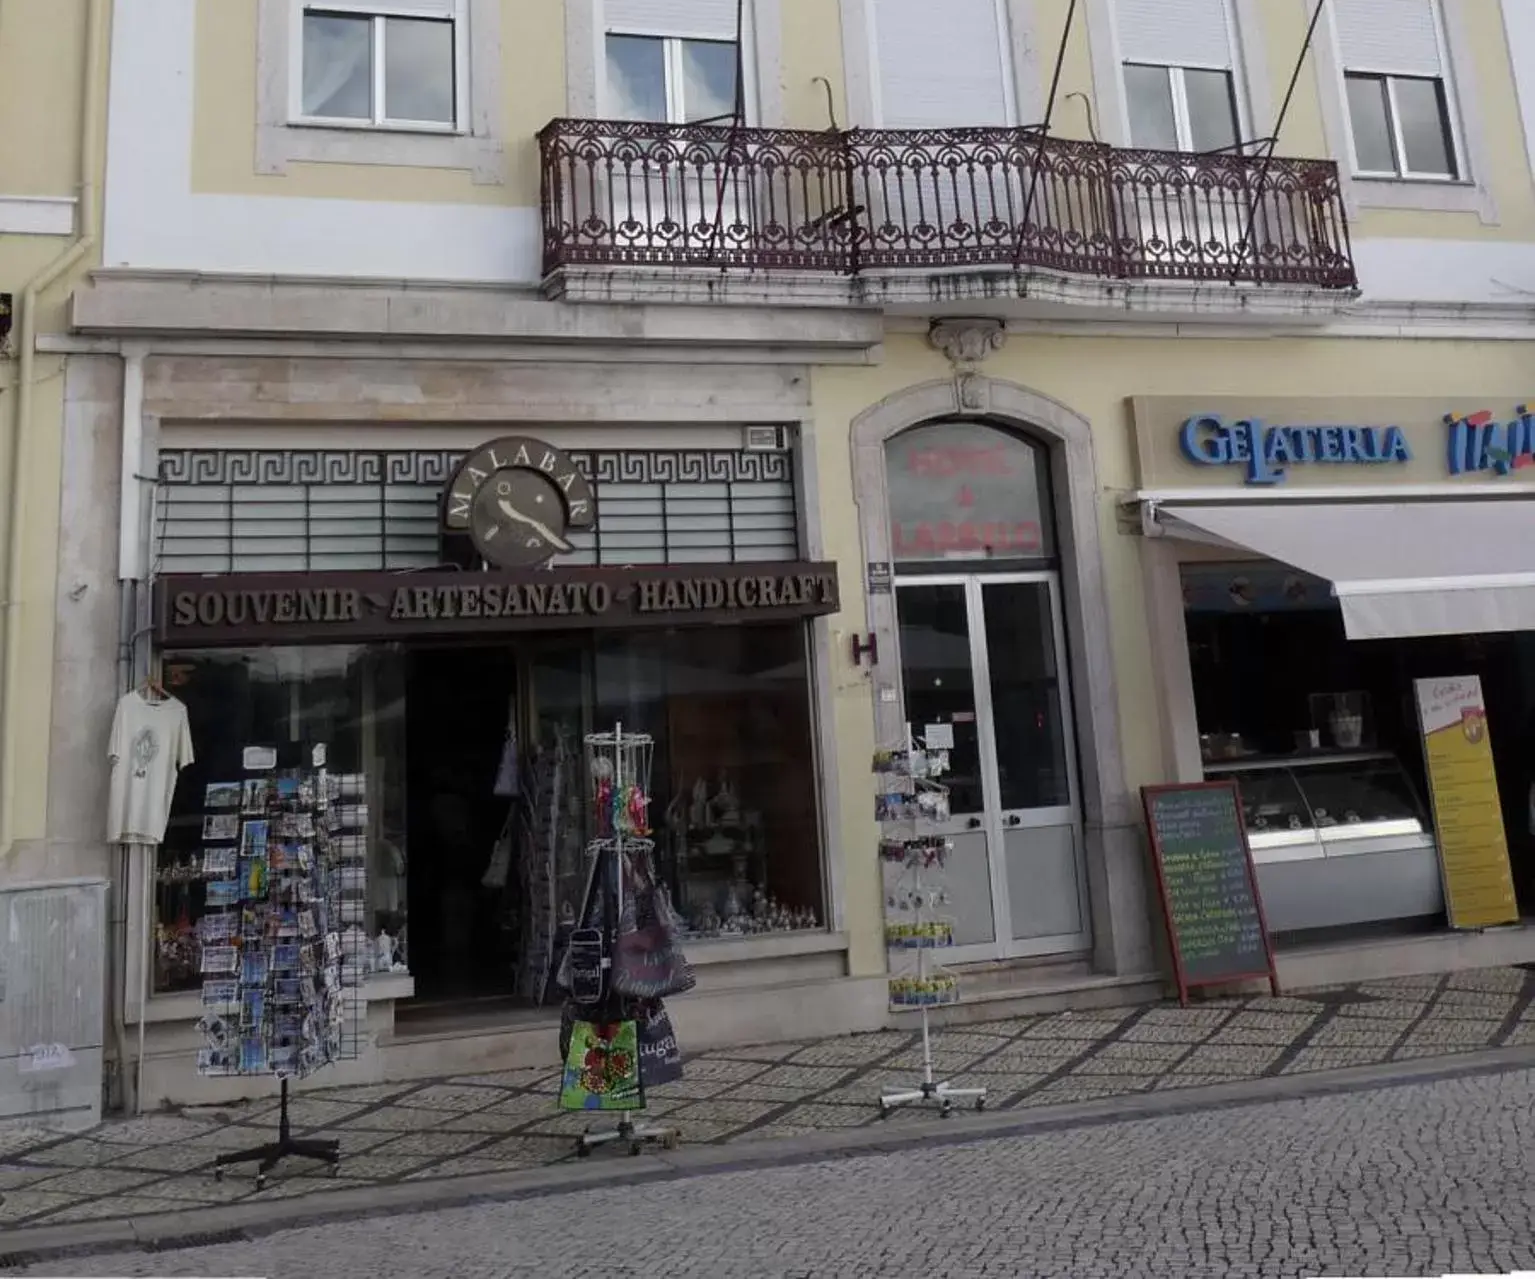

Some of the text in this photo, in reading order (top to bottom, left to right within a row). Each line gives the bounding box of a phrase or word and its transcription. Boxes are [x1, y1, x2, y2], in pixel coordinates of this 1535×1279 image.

[449, 443, 588, 520] MALABAR
[173, 587, 363, 627] SOUVENIR
[390, 581, 612, 619] ARTESANATO
[637, 574, 834, 612] HANDICRAFT
[852, 631, 878, 665] H
